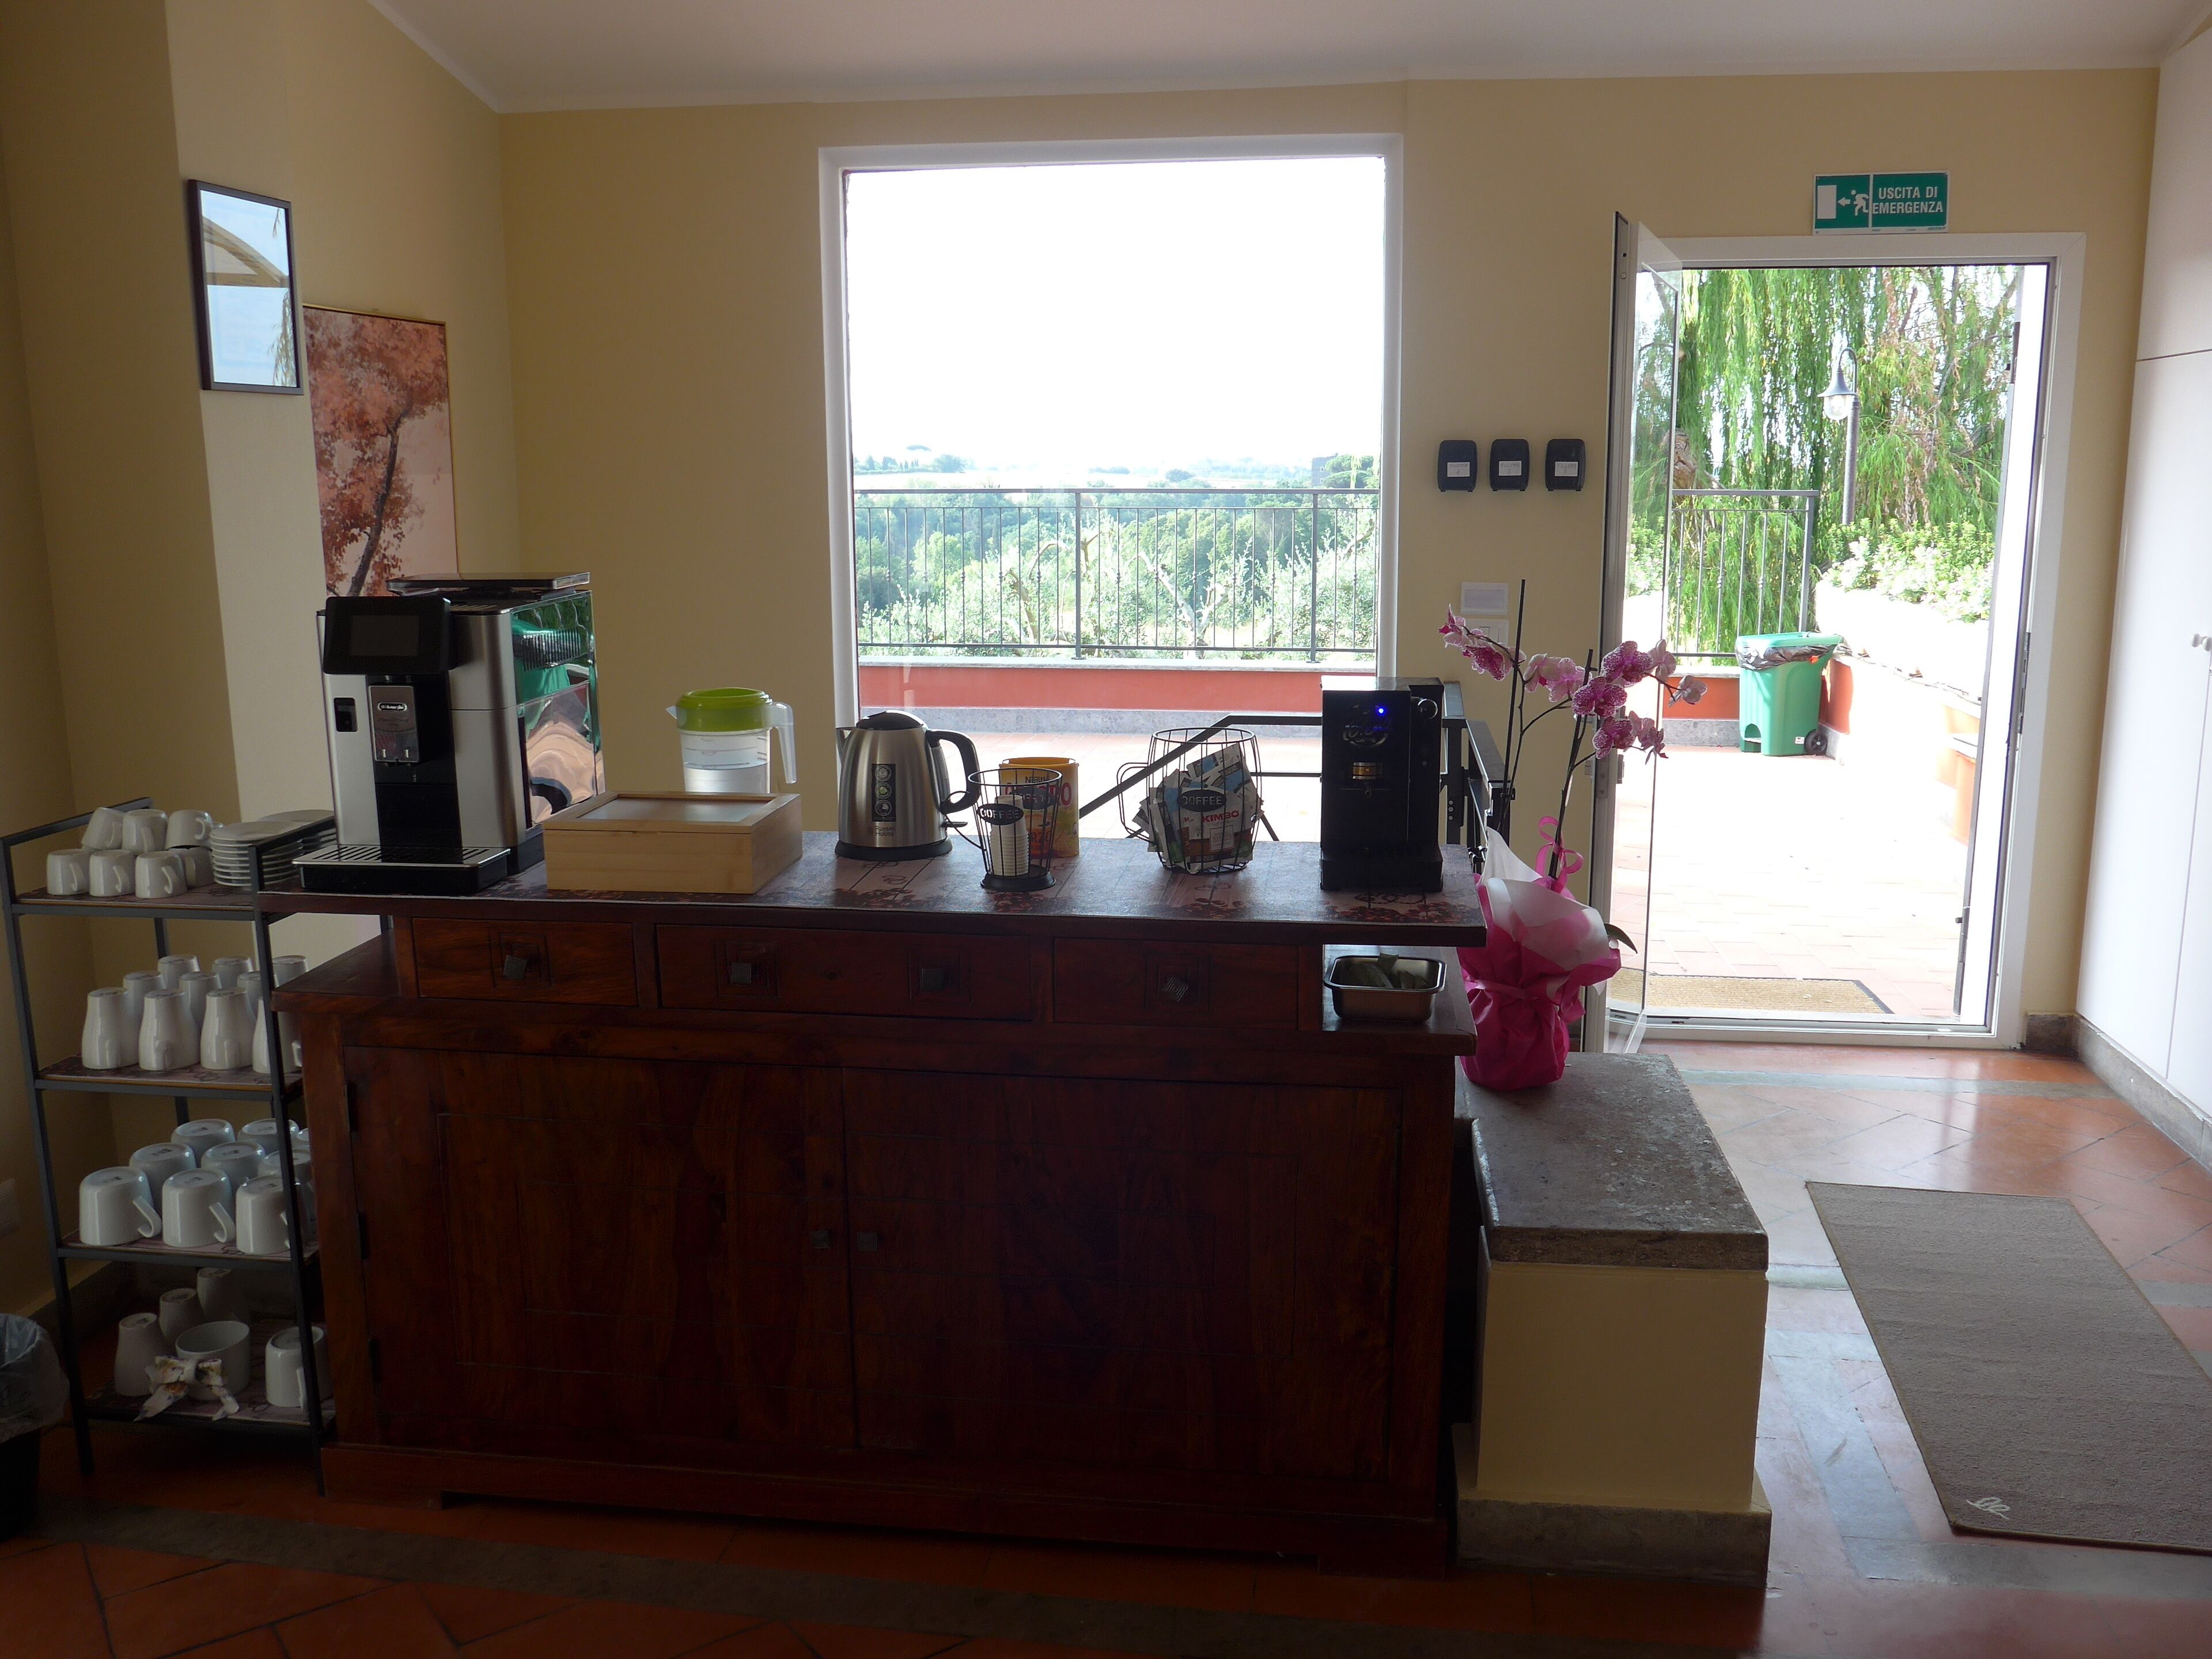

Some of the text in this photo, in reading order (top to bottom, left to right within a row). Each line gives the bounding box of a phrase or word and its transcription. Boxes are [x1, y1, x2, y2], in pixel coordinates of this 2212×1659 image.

[1878, 186, 1938, 199] USCITA DI
[1872, 201, 1944, 214] EMERGENZA
[1181, 796, 1222, 805] COFFEE
[979, 808, 1020, 819] COFFEE
[1202, 810, 1240, 823] KIMBO
